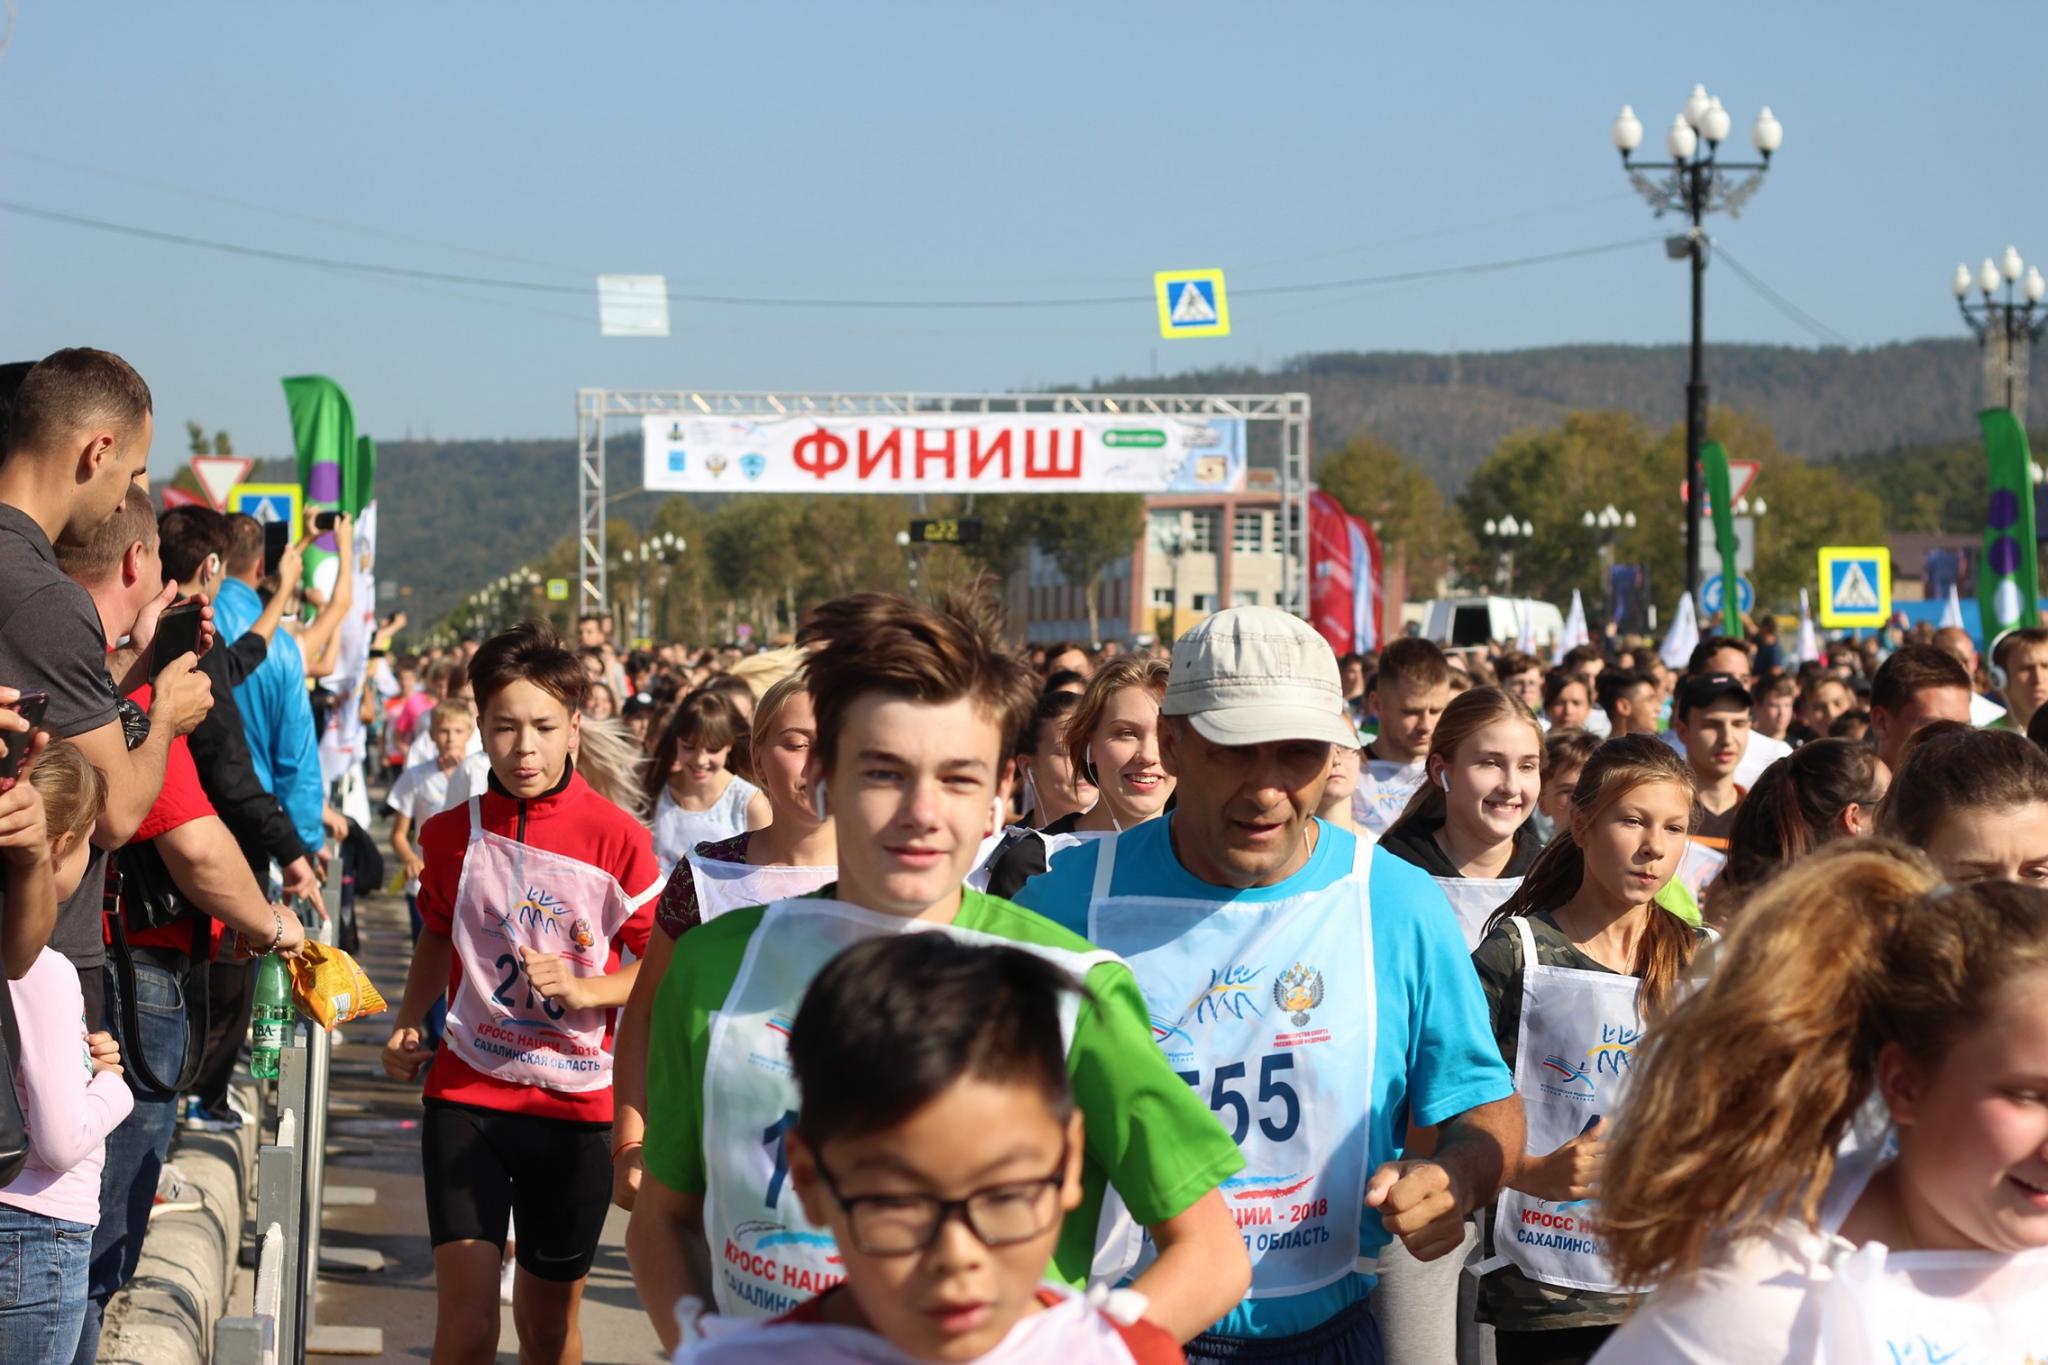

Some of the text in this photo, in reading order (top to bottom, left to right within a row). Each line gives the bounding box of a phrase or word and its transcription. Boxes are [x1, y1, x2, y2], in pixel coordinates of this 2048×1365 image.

[792, 426, 1083, 479] ФИНИШ
[473, 1037, 600, 1071] САХАЛИНСКАЯ ОБЛАСТЬ
[477, 1022, 514, 1042] КРОСС
[516, 1033, 561, 1053] НАЦИИ
[571, 1044, 599, 1056] 2018
[1231, 1206, 1272, 1229] ЦИИ
[1290, 1198, 1328, 1223] 2018
[1521, 1208, 1575, 1231] КРОСС
[1257, 1225, 1330, 1251] ОБЛАСТЬ
